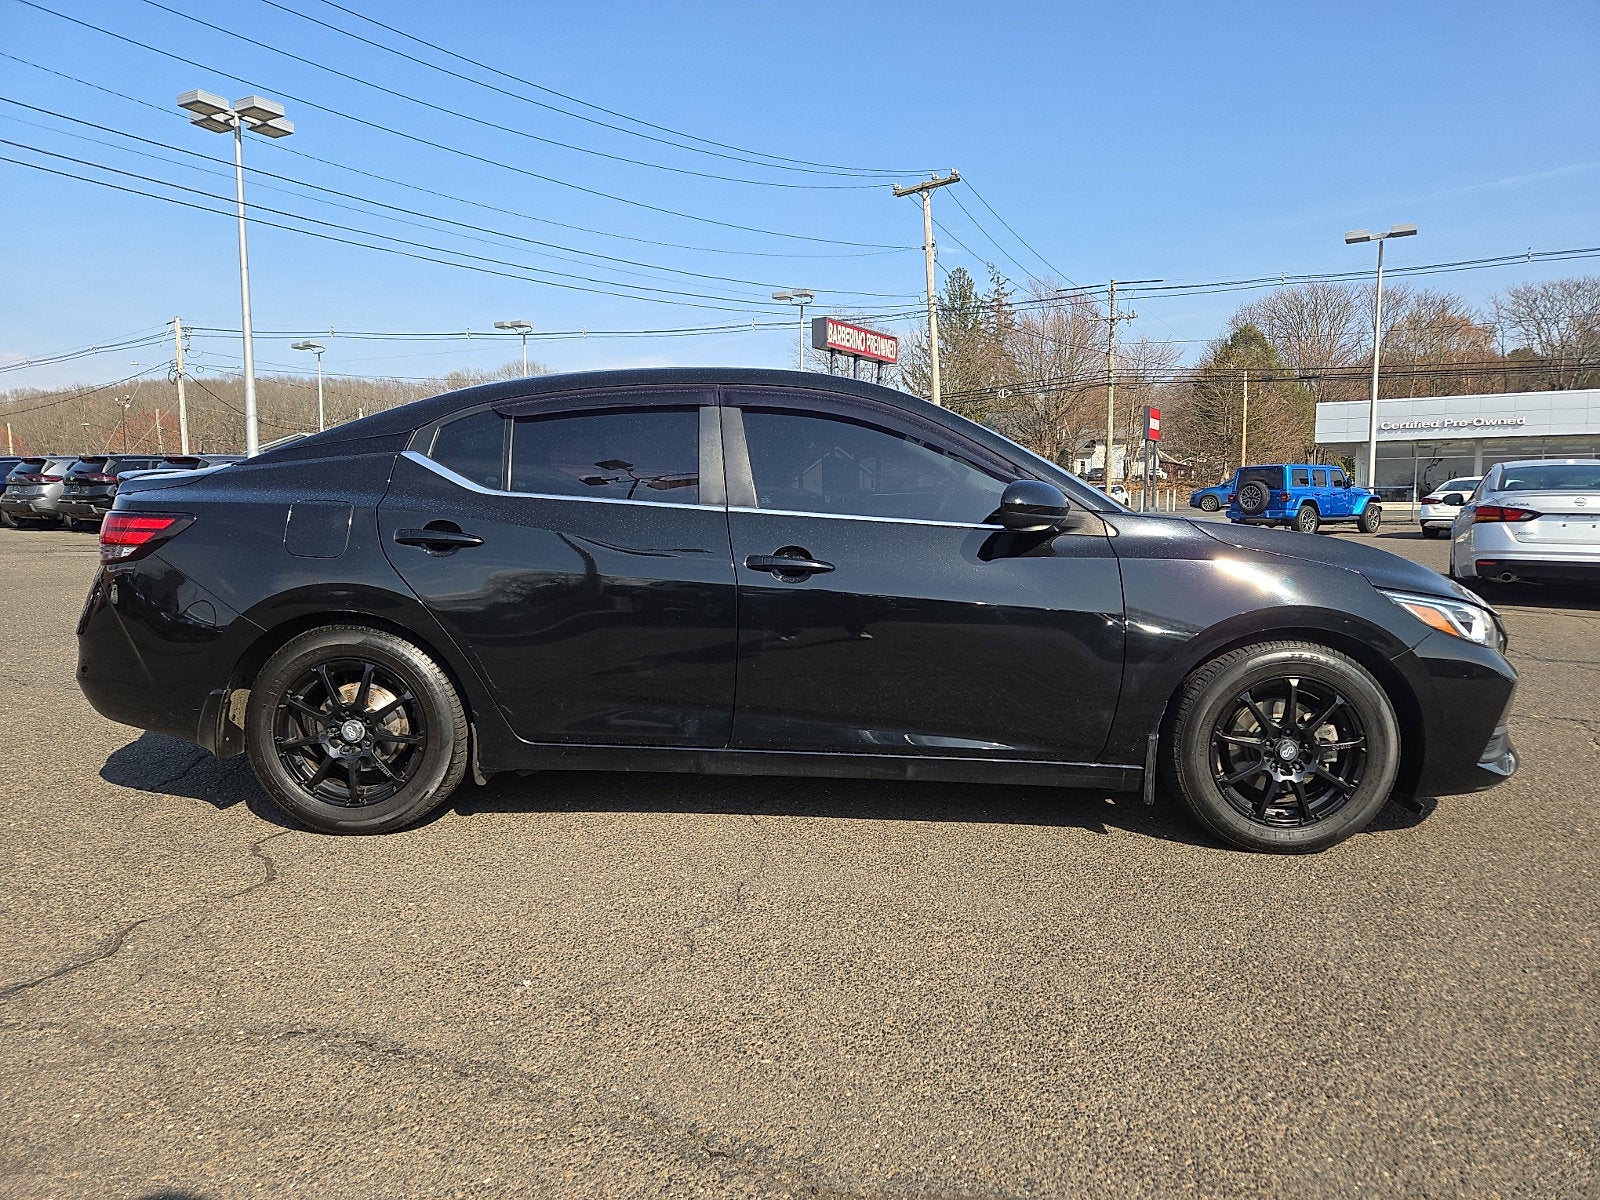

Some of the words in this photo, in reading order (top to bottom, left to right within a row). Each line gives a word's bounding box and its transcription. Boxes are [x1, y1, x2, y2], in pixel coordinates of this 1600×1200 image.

[828, 322, 865, 351] BARBERINO
[1380, 419, 1439, 430] Certified
[1444, 416, 1526, 427] Pre-Owned
